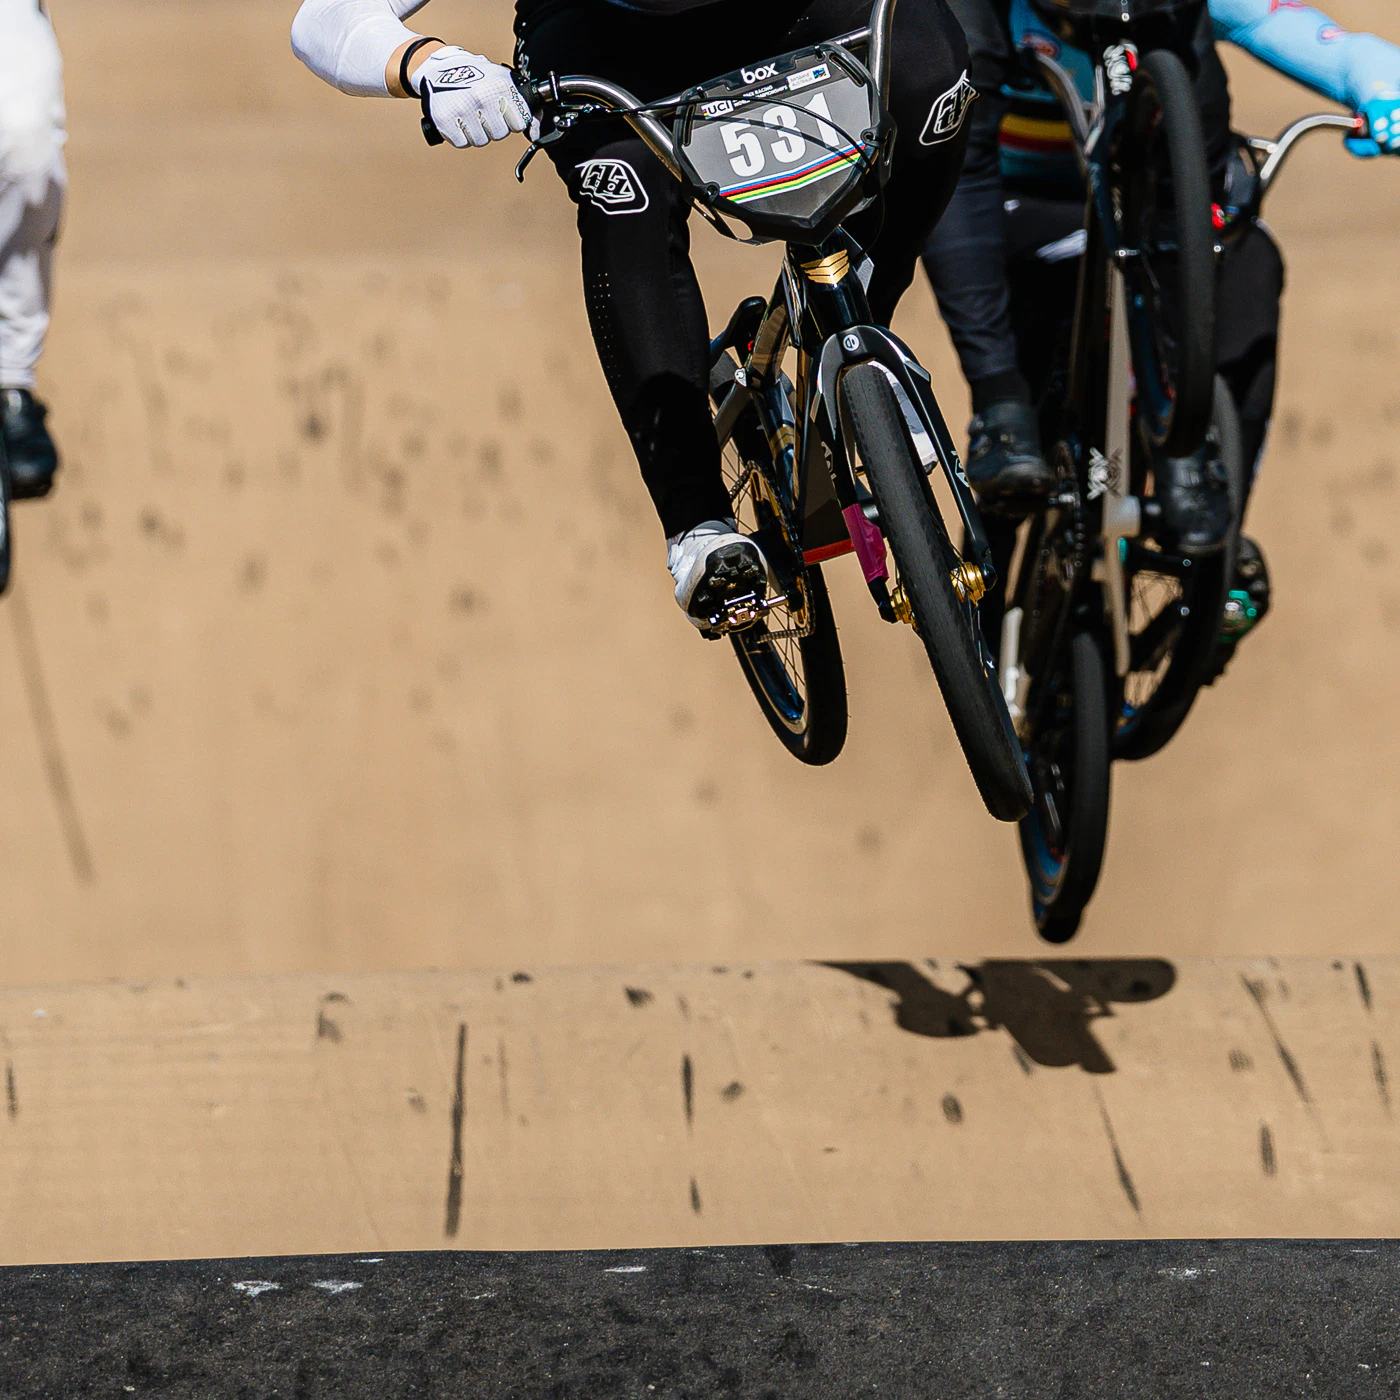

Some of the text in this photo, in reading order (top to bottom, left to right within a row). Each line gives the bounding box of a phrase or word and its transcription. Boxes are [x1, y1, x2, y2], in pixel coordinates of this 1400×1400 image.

[740, 62, 780, 85] box
[707, 100, 731, 115] UCI
[718, 91, 841, 177] 531
